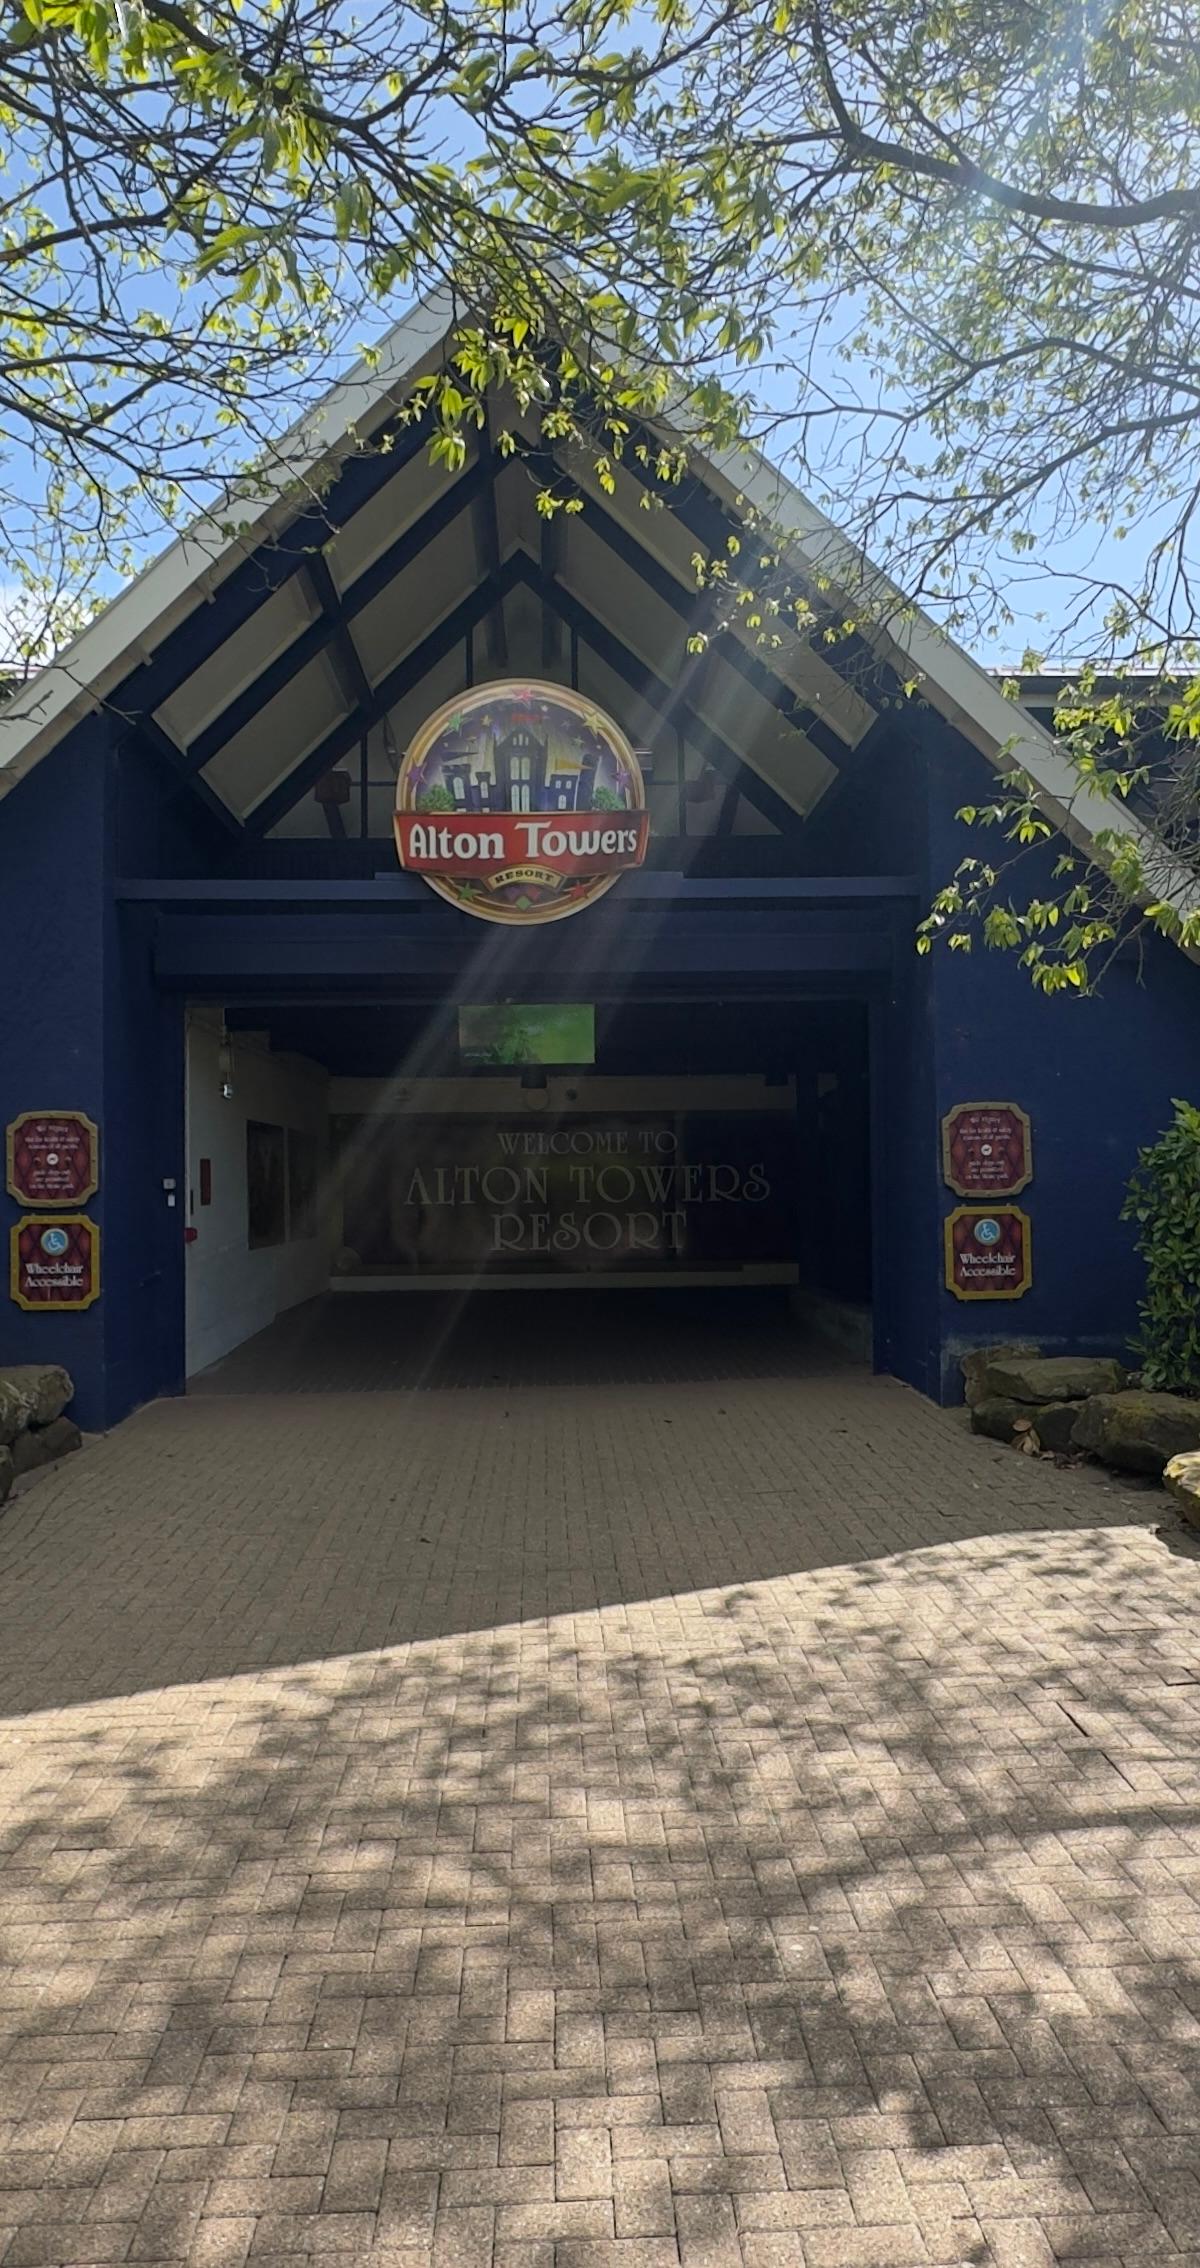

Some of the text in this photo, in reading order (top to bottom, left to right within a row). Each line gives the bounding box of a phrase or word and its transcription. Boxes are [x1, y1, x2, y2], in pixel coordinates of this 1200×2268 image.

[409, 821, 637, 859] Alton Towers
[494, 869, 555, 884] RESORT
[497, 1130, 678, 1155] WELCOME TO
[404, 1163, 771, 1206] ALTON TOWERS
[490, 1208, 687, 1252] RESORT
[960, 1251, 1016, 1264] Wheelchair
[24, 1262, 84, 1275] Wheelchair
[960, 1264, 1016, 1277] Accessible
[24, 1275, 84, 1288] Accessible
